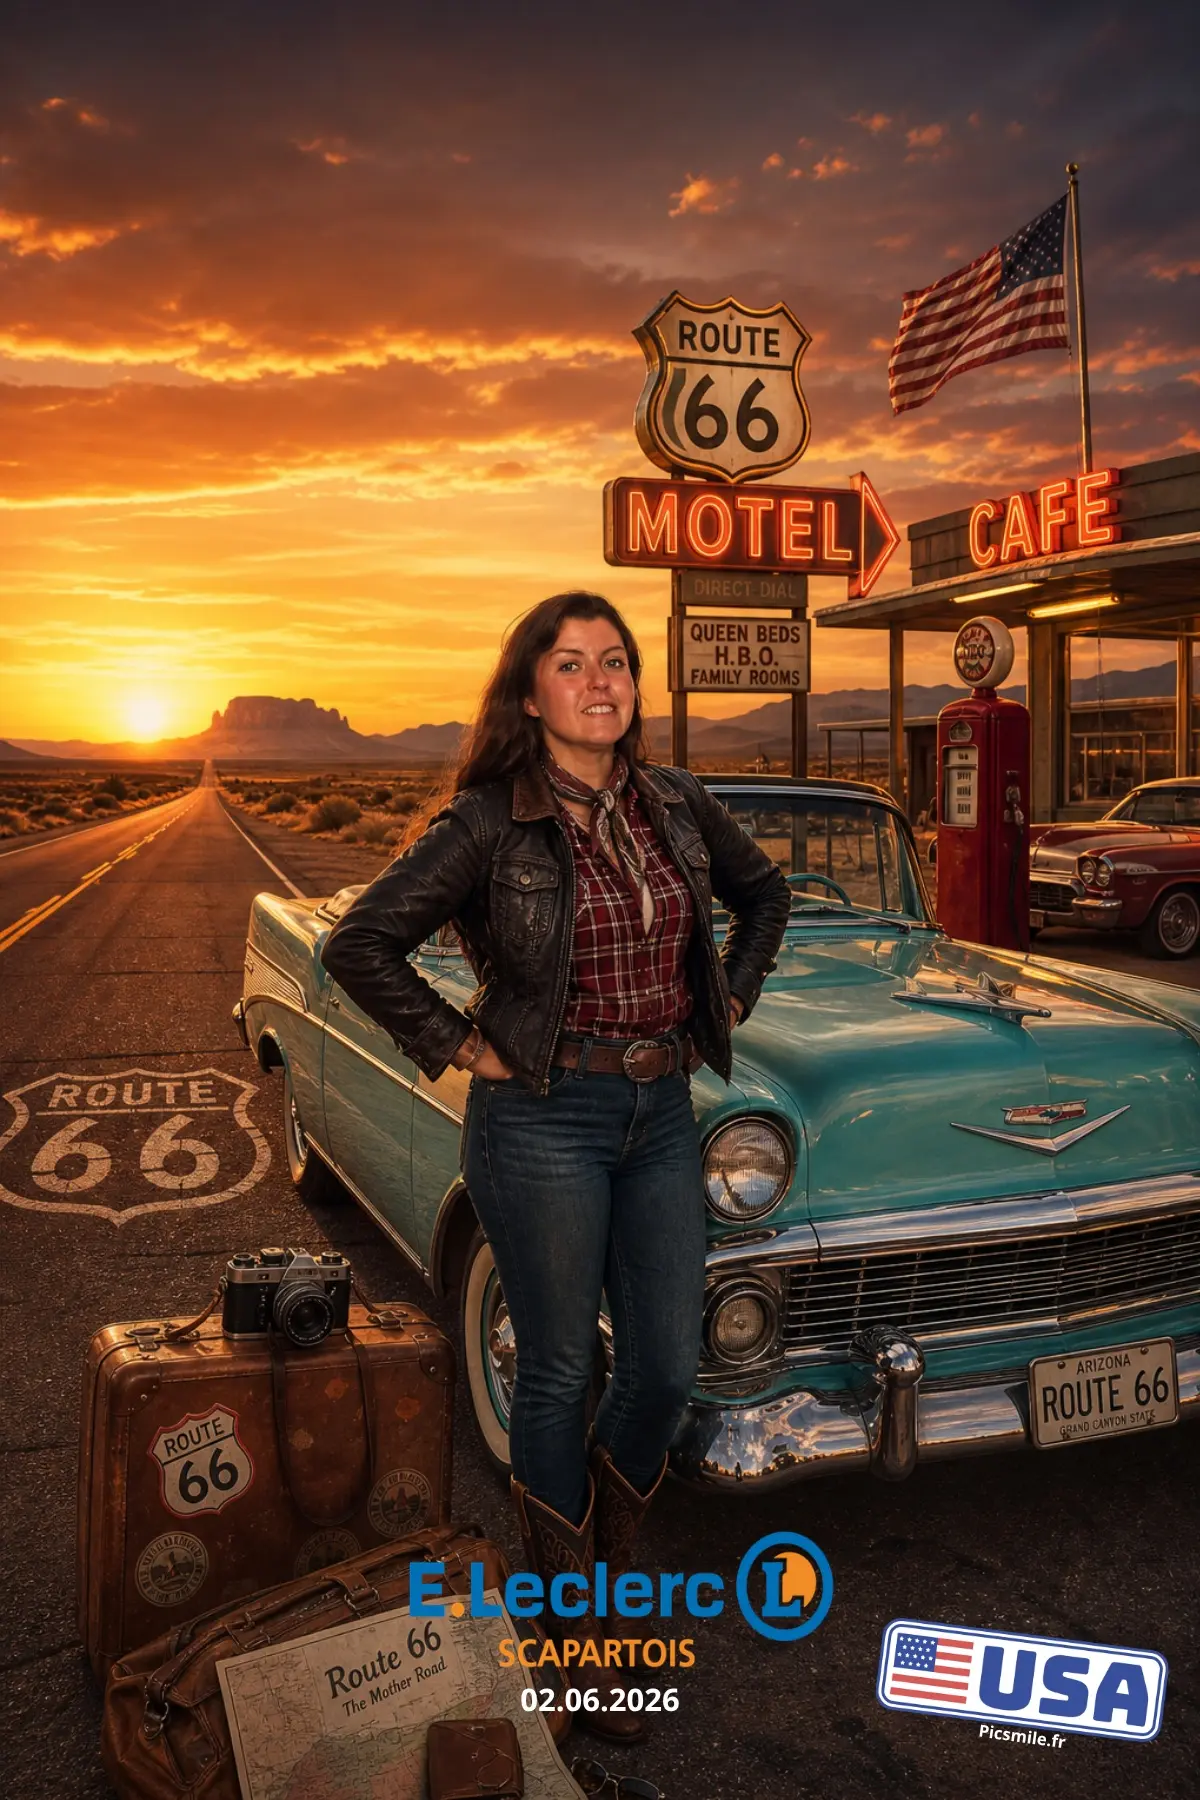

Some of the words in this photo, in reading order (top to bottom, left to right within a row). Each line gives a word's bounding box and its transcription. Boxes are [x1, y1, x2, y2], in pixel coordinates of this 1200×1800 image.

[678, 319, 780, 358] ROUTE
[684, 373, 779, 453] 66
[627, 491, 853, 561] MOTEL
[969, 468, 1120, 570] CAFE
[694, 579, 752, 597] DIRECT
[761, 581, 797, 599] DIAL
[690, 623, 748, 643] QUEEN
[757, 624, 800, 644] BEDS
[715, 646, 779, 666] H.B.O.
[691, 669, 742, 685] FAMILY
[750, 669, 800, 686] ROOMS
[47, 1080, 217, 1108] ROUTE
[30, 1114, 221, 1193] 66
[1076, 1353, 1131, 1375] ARIZONA
[1042, 1374, 1124, 1423] ROUTE
[1134, 1366, 1169, 1406] 66
[163, 1417, 225, 1457] ROUTE
[1060, 1421, 1090, 1436] GRAND
[1092, 1415, 1127, 1430] CANYON
[1130, 1409, 1156, 1424] STATE
[179, 1447, 239, 1504] 66
[325, 1650, 401, 1699] Route
[407, 1621, 441, 1659] 66
[342, 1698, 367, 1717] The
[369, 1677, 411, 1705] Mother
[414, 1656, 448, 1682] Road
